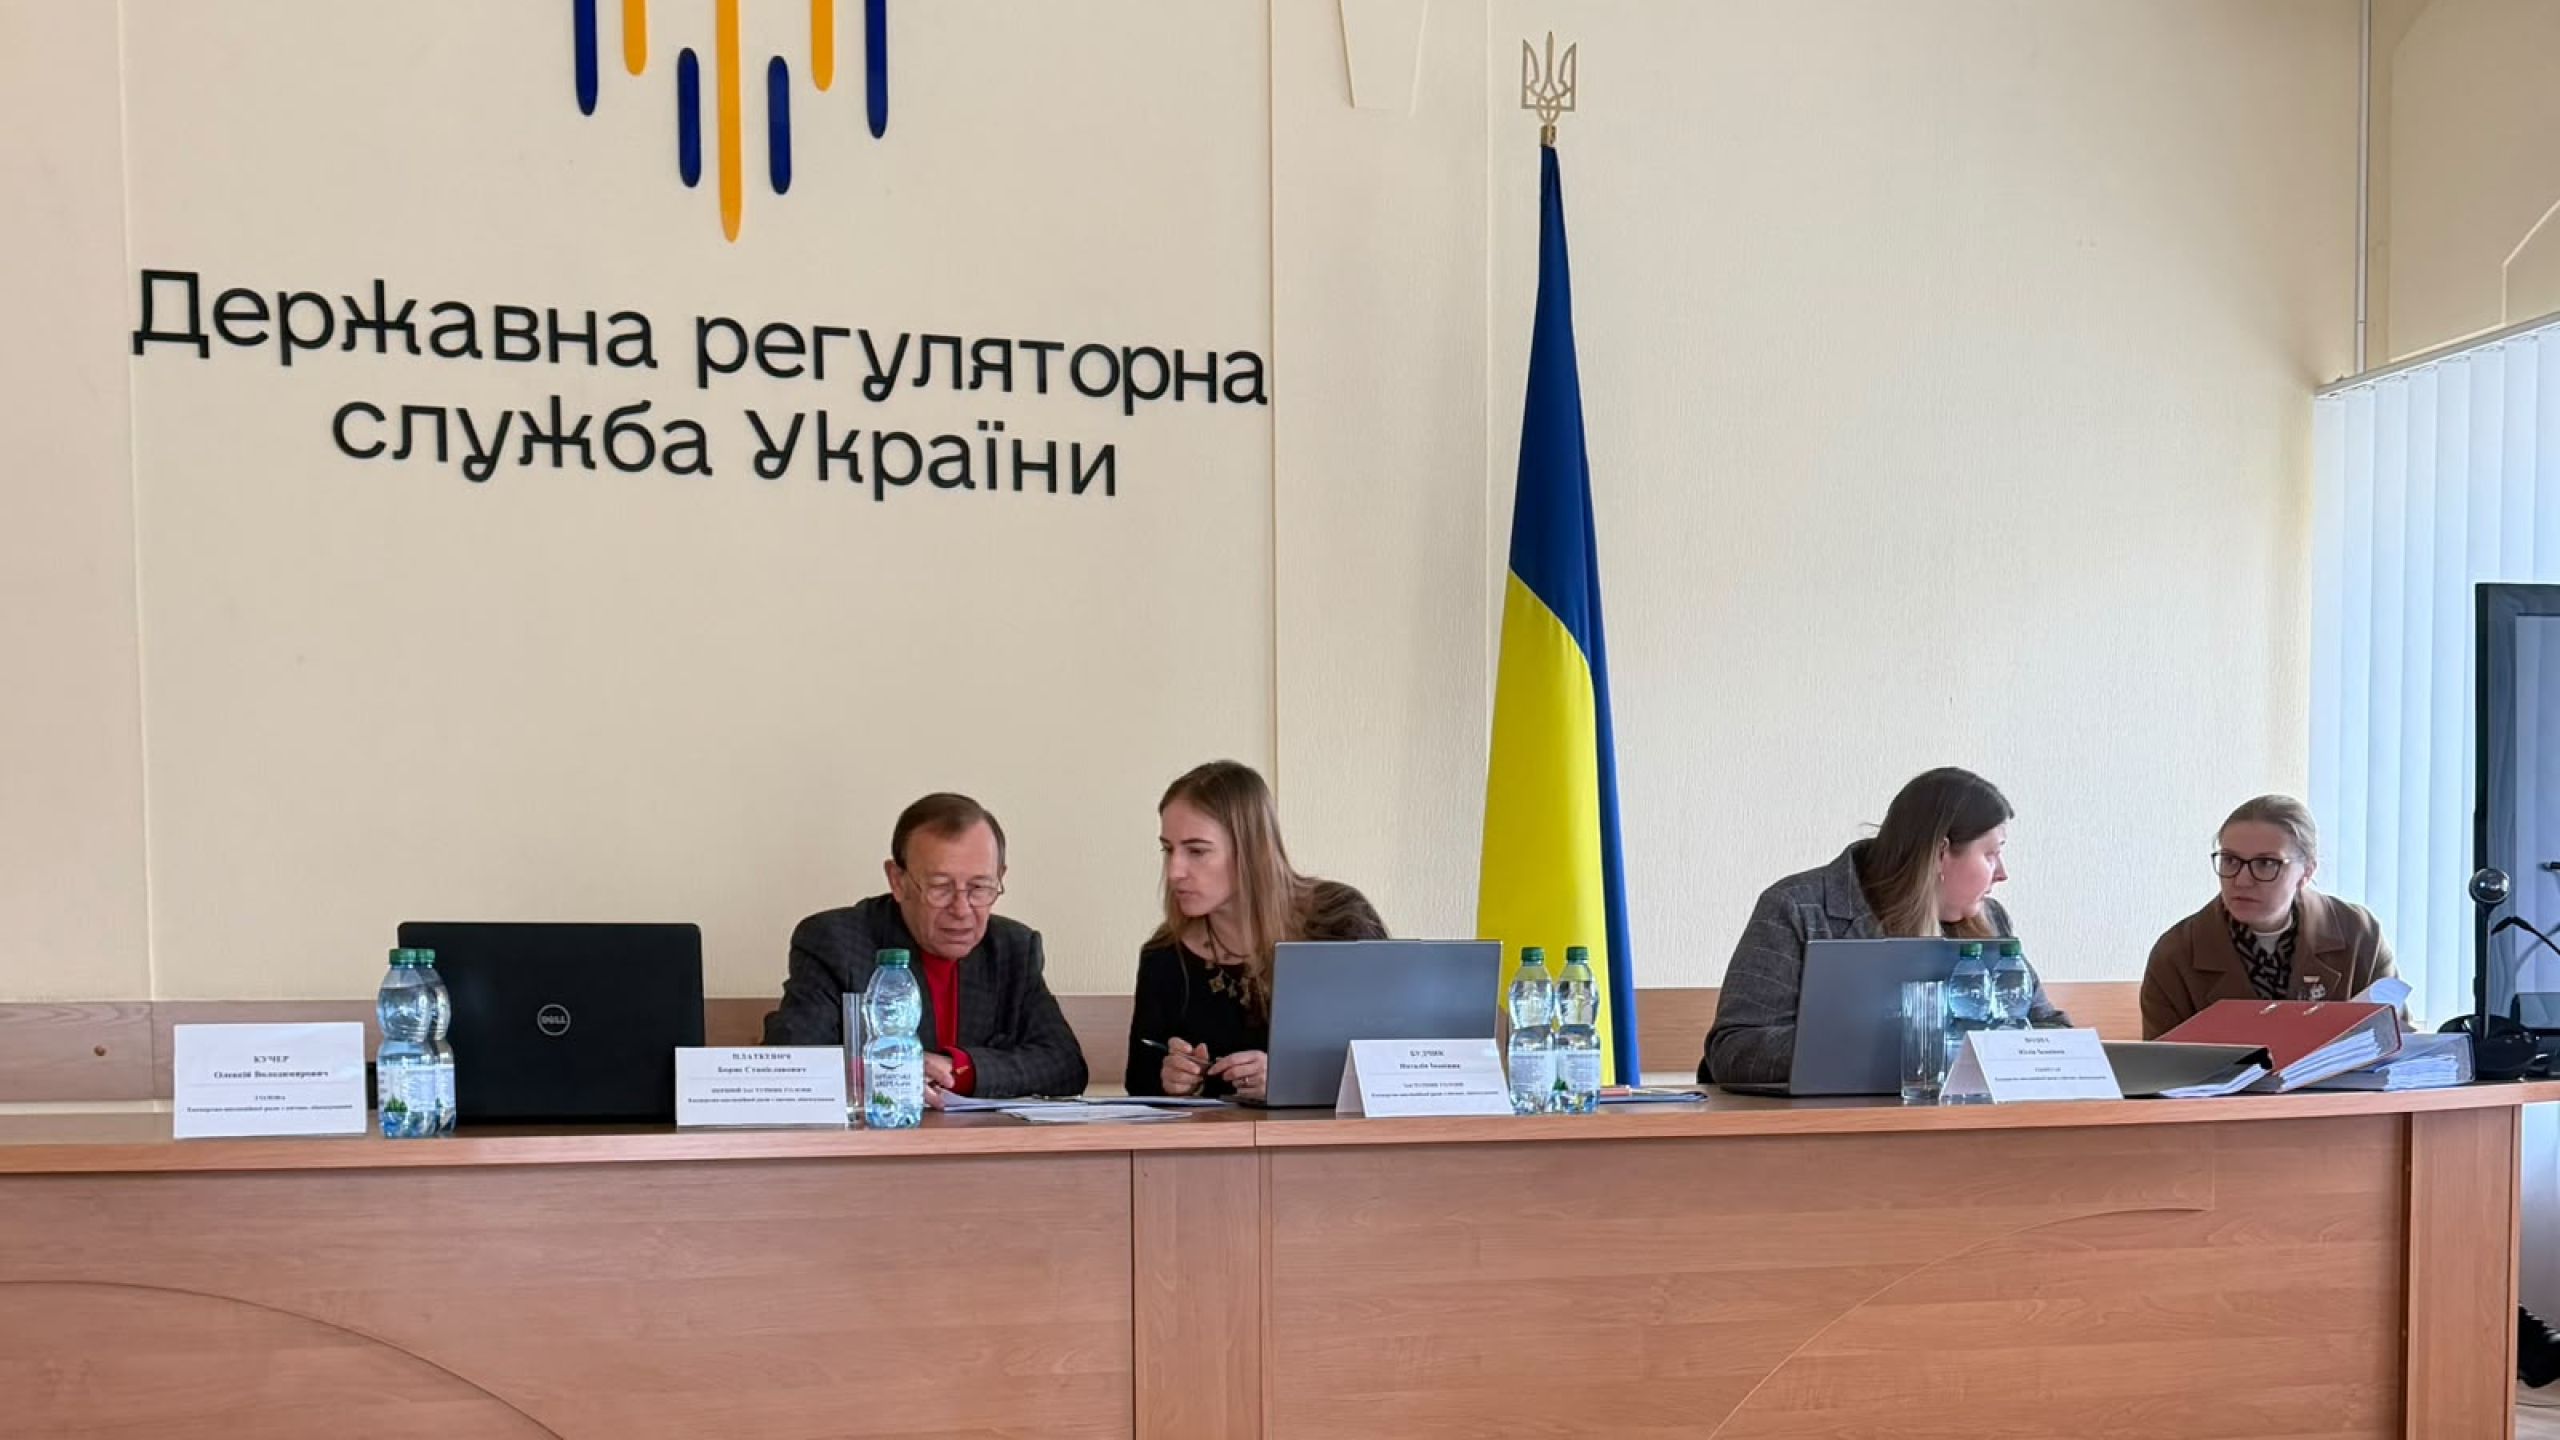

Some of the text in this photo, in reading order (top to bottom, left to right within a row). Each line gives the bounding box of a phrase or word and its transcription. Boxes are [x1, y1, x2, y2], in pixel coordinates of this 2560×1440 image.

[132, 269, 1268, 417] Державна регуляторна
[332, 394, 1116, 502] служба України
